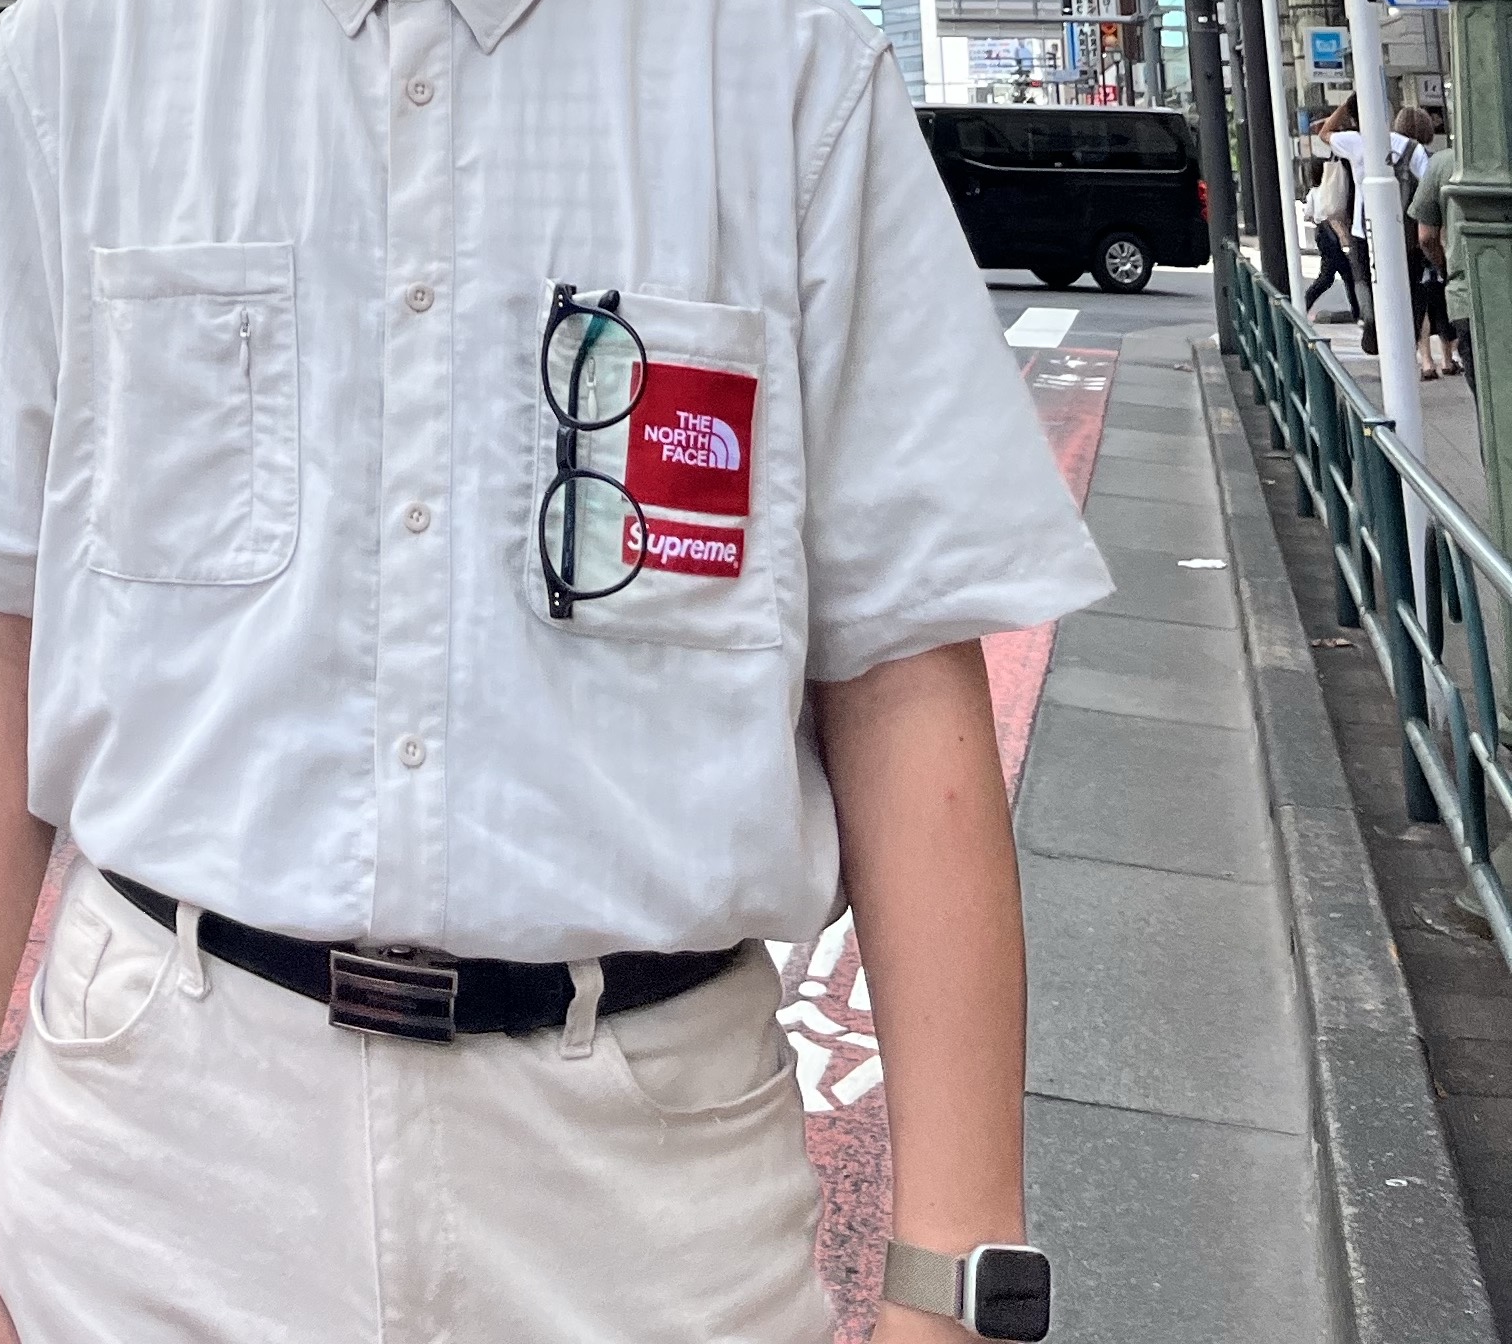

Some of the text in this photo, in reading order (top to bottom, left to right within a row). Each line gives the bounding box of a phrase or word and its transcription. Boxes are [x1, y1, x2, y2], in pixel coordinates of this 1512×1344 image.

[676, 409, 712, 434] THE
[644, 425, 710, 449] NORTH
[662, 445, 709, 467] FACE
[626, 520, 737, 565] Supreme
